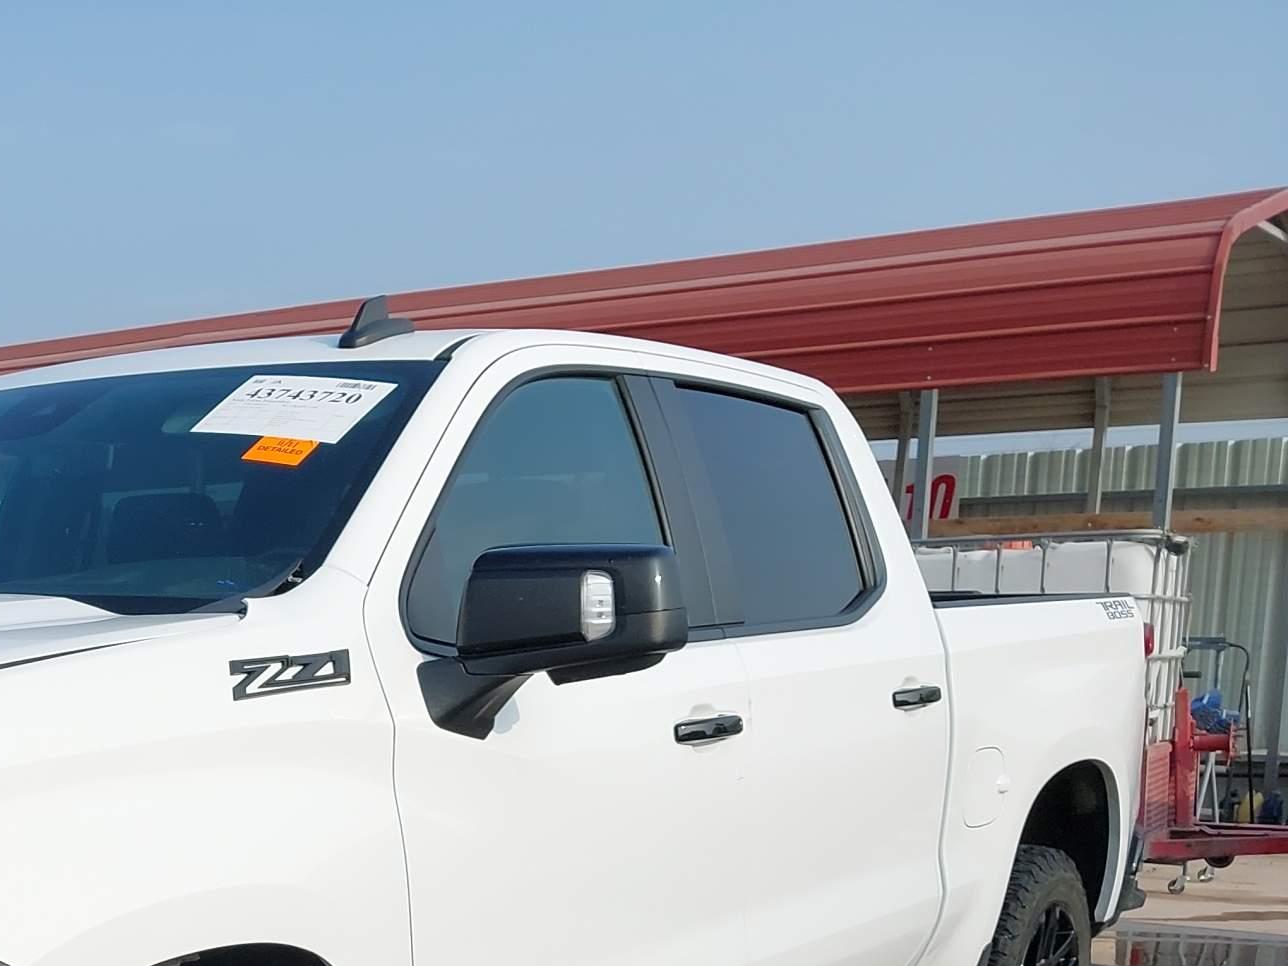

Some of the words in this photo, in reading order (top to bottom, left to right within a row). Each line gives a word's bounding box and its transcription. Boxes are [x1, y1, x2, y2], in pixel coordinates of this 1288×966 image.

[246, 388, 363, 405] 43743720
[257, 445, 304, 456] DETAILED
[1096, 600, 1134, 611] TRAIL
[1107, 610, 1134, 620] BOSS
[229, 649, 351, 701] Z71
